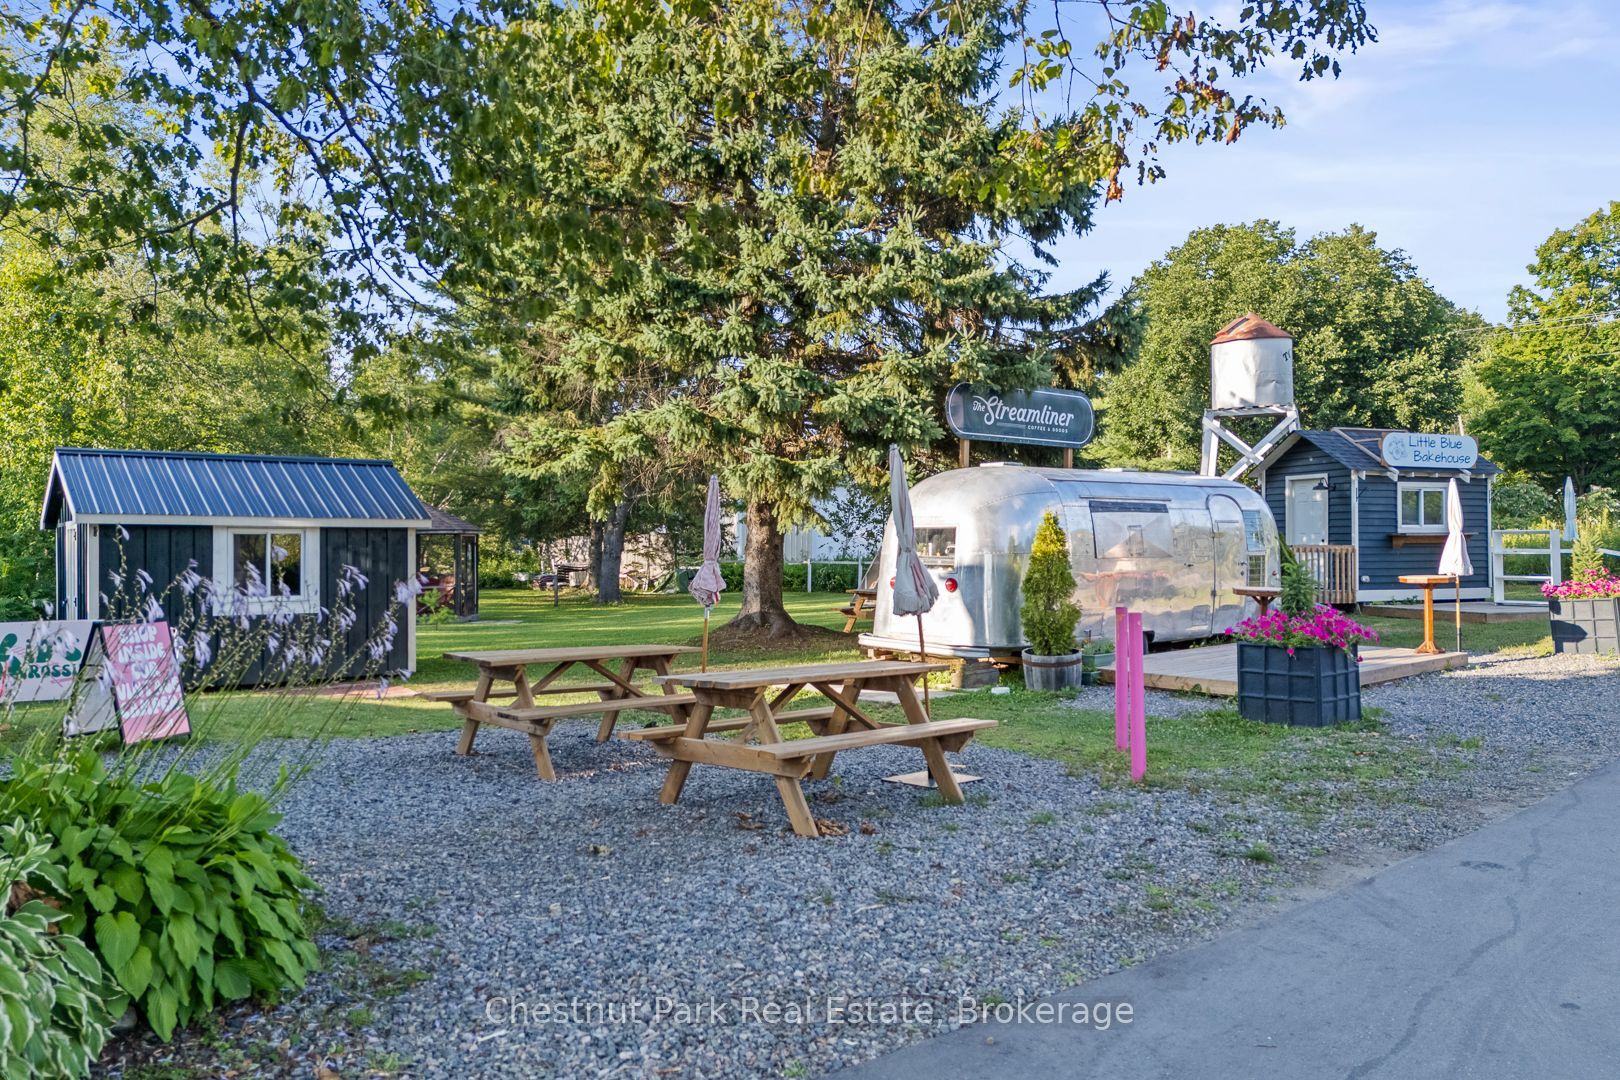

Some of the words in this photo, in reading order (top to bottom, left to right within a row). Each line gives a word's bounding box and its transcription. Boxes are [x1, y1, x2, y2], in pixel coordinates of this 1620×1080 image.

[972, 401, 985, 412] The
[973, 395, 1074, 426] Streamliner
[1408, 435, 1436, 448] Little
[1440, 437, 1463, 449] Blue
[1413, 450, 1471, 463] Bakehouse
[118, 642, 166, 662] INSIDE
